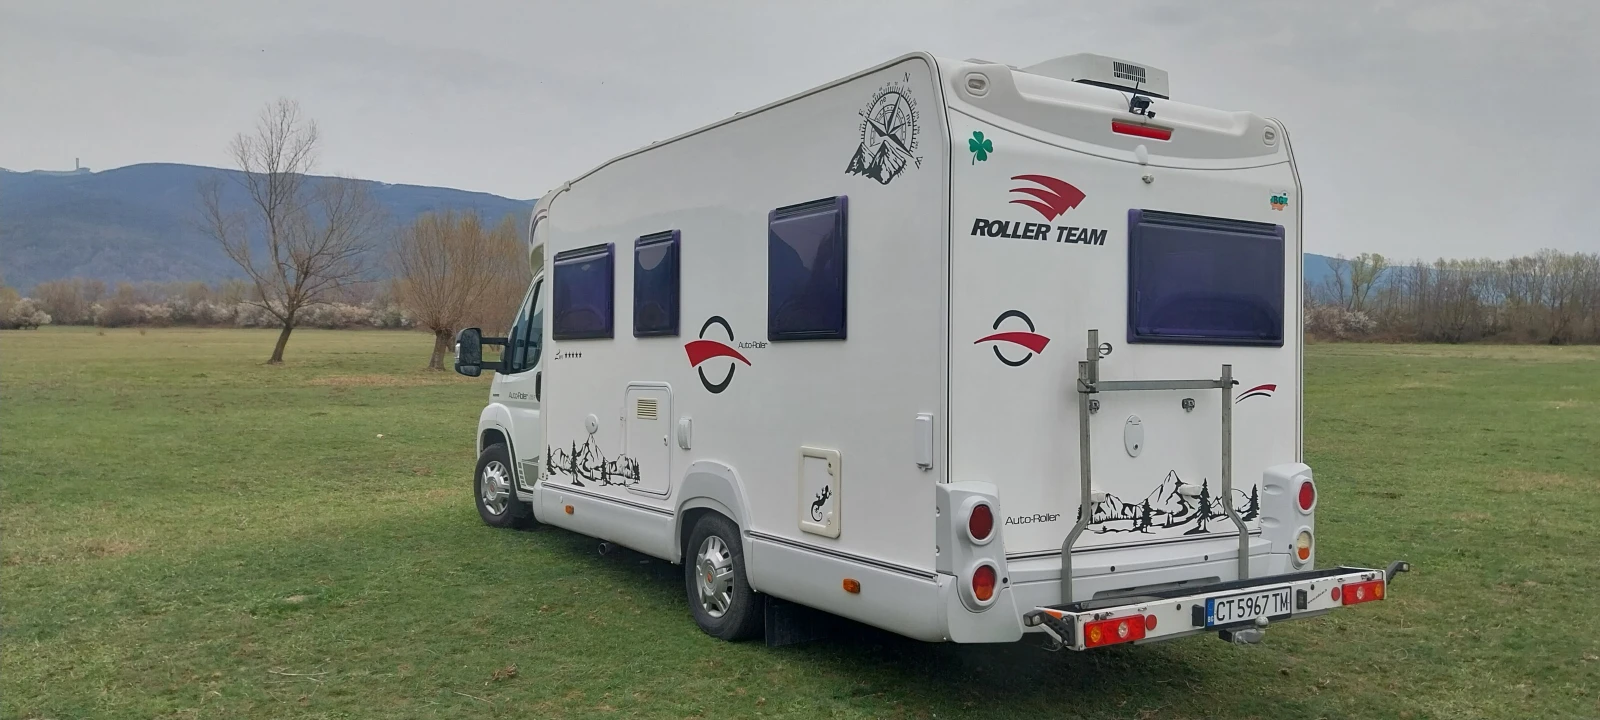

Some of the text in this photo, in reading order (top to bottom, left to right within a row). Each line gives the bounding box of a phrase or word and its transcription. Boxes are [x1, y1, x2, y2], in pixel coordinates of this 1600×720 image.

[903, 72, 910, 82] N
[971, 218, 1108, 246] ROLLER TEAM
[1005, 513, 1060, 525] Auto-Roller
[1216, 600, 1234, 621] CT
[1237, 594, 1269, 618] 5967
[1272, 592, 1289, 613] TM
